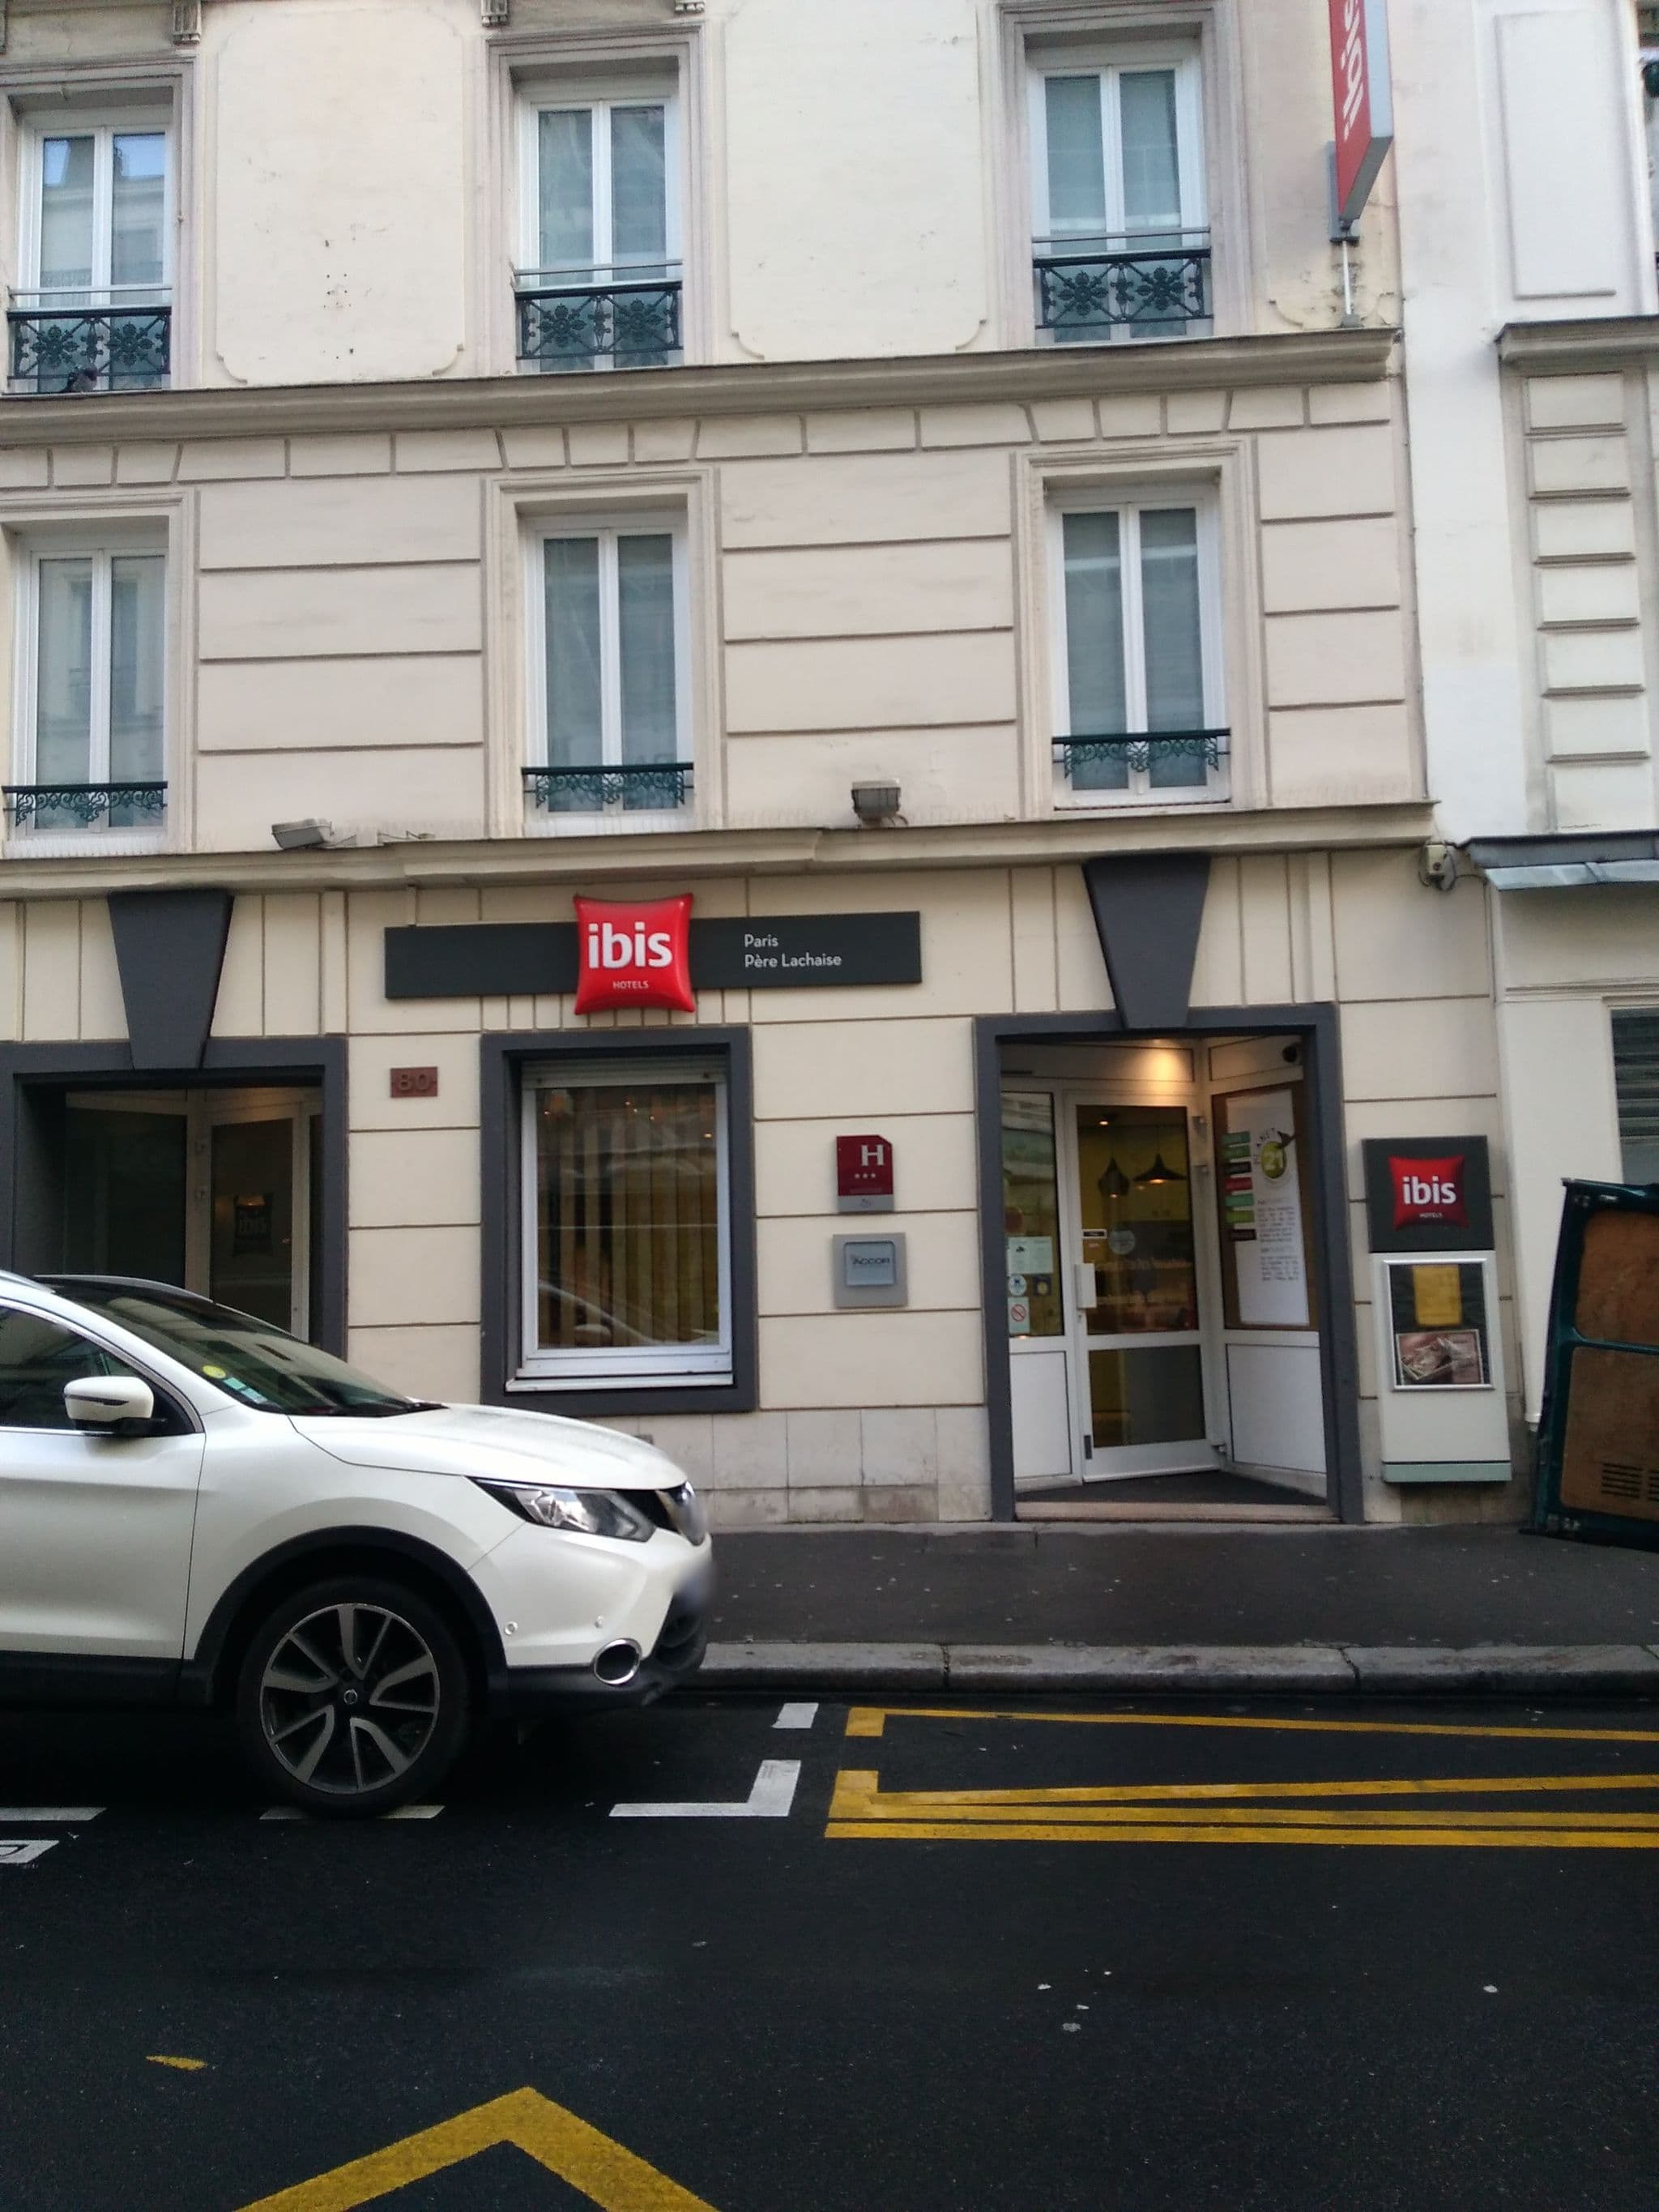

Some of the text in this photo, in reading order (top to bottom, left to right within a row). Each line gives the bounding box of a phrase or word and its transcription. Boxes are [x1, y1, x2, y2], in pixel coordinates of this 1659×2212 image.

[588, 921, 672, 968] ibis
[744, 933, 779, 947] Paris
[744, 952, 842, 968] Père Lachaise
[612, 980, 650, 989] HOTELS
[861, 1144, 885, 1166] H
[1402, 1176, 1456, 1205] ibis
